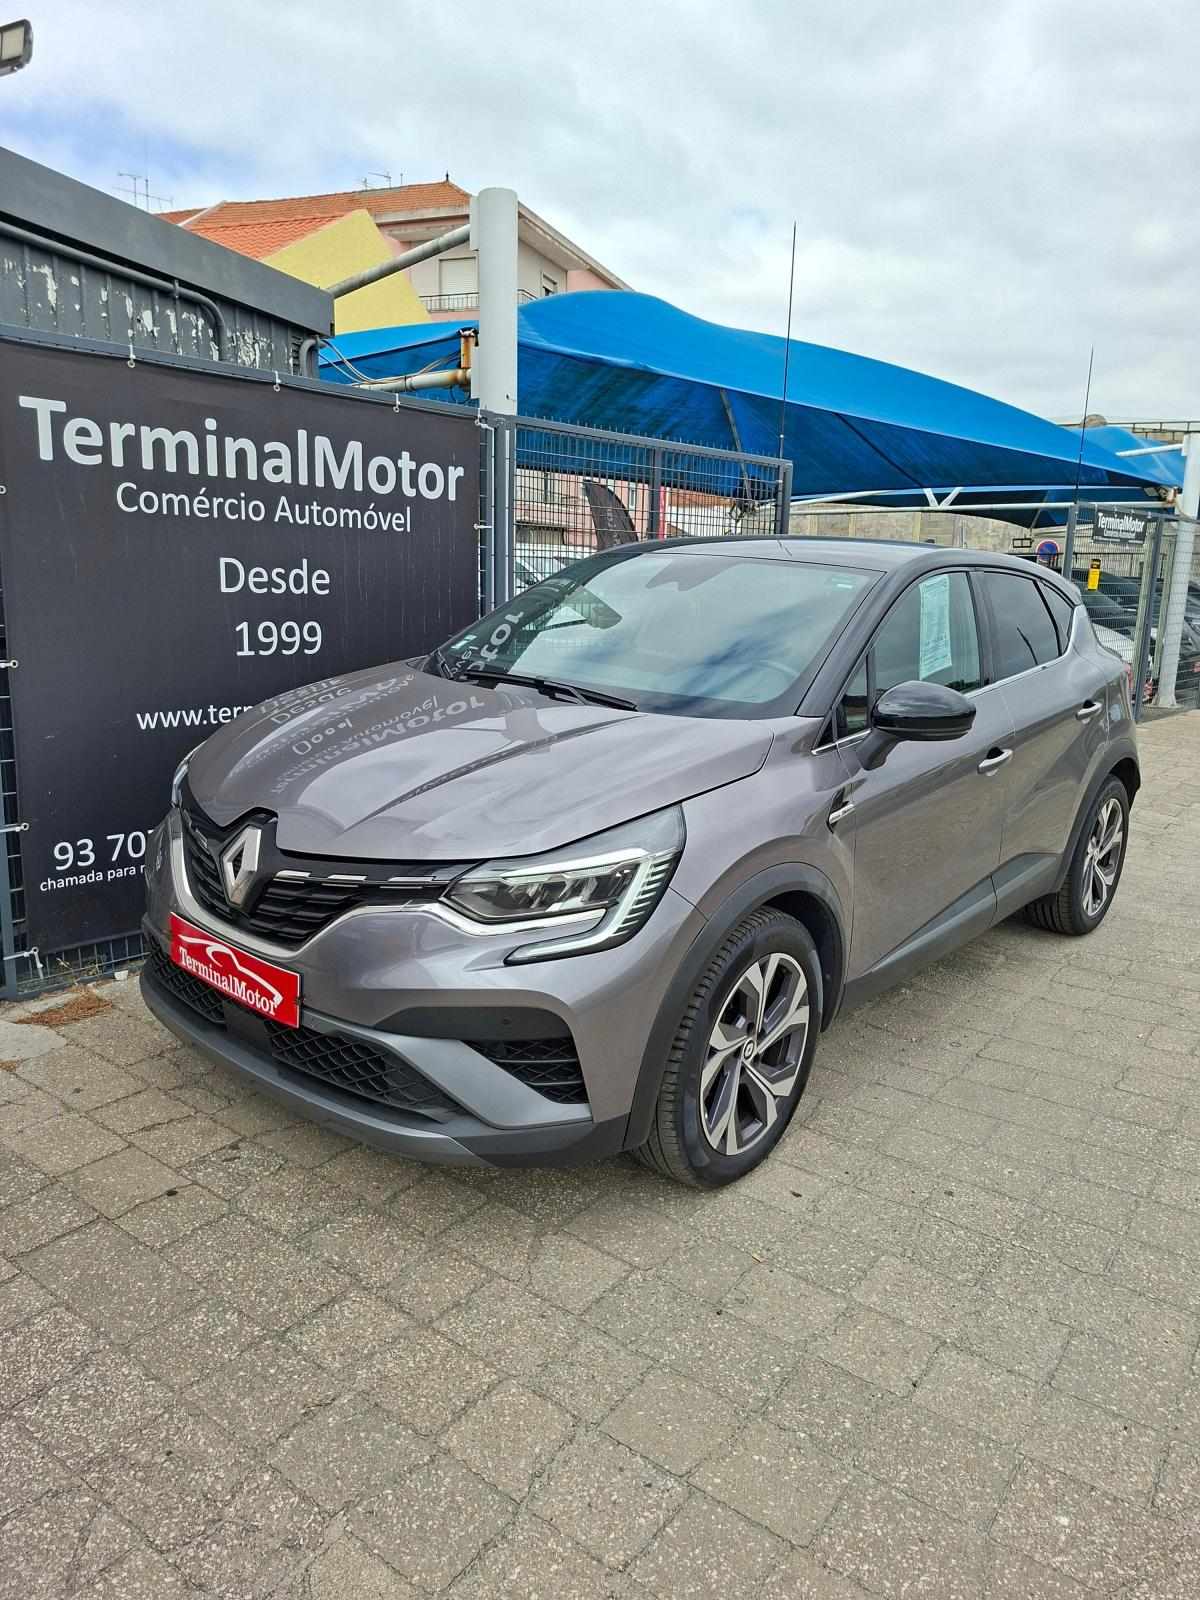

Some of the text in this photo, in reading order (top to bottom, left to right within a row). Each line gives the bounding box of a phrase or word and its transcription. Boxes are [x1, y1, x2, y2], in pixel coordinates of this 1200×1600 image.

[18, 395, 466, 502] TerminalMotor
[116, 481, 412, 533] Comércio Automóvel
[219, 557, 331, 595] Desde
[235, 621, 322, 656] 1999
[53, 829, 154, 871] 93 70
[40, 869, 103, 892] chamada
[107, 866, 136, 882] para
[178, 946, 278, 1016] TerminalMotor
